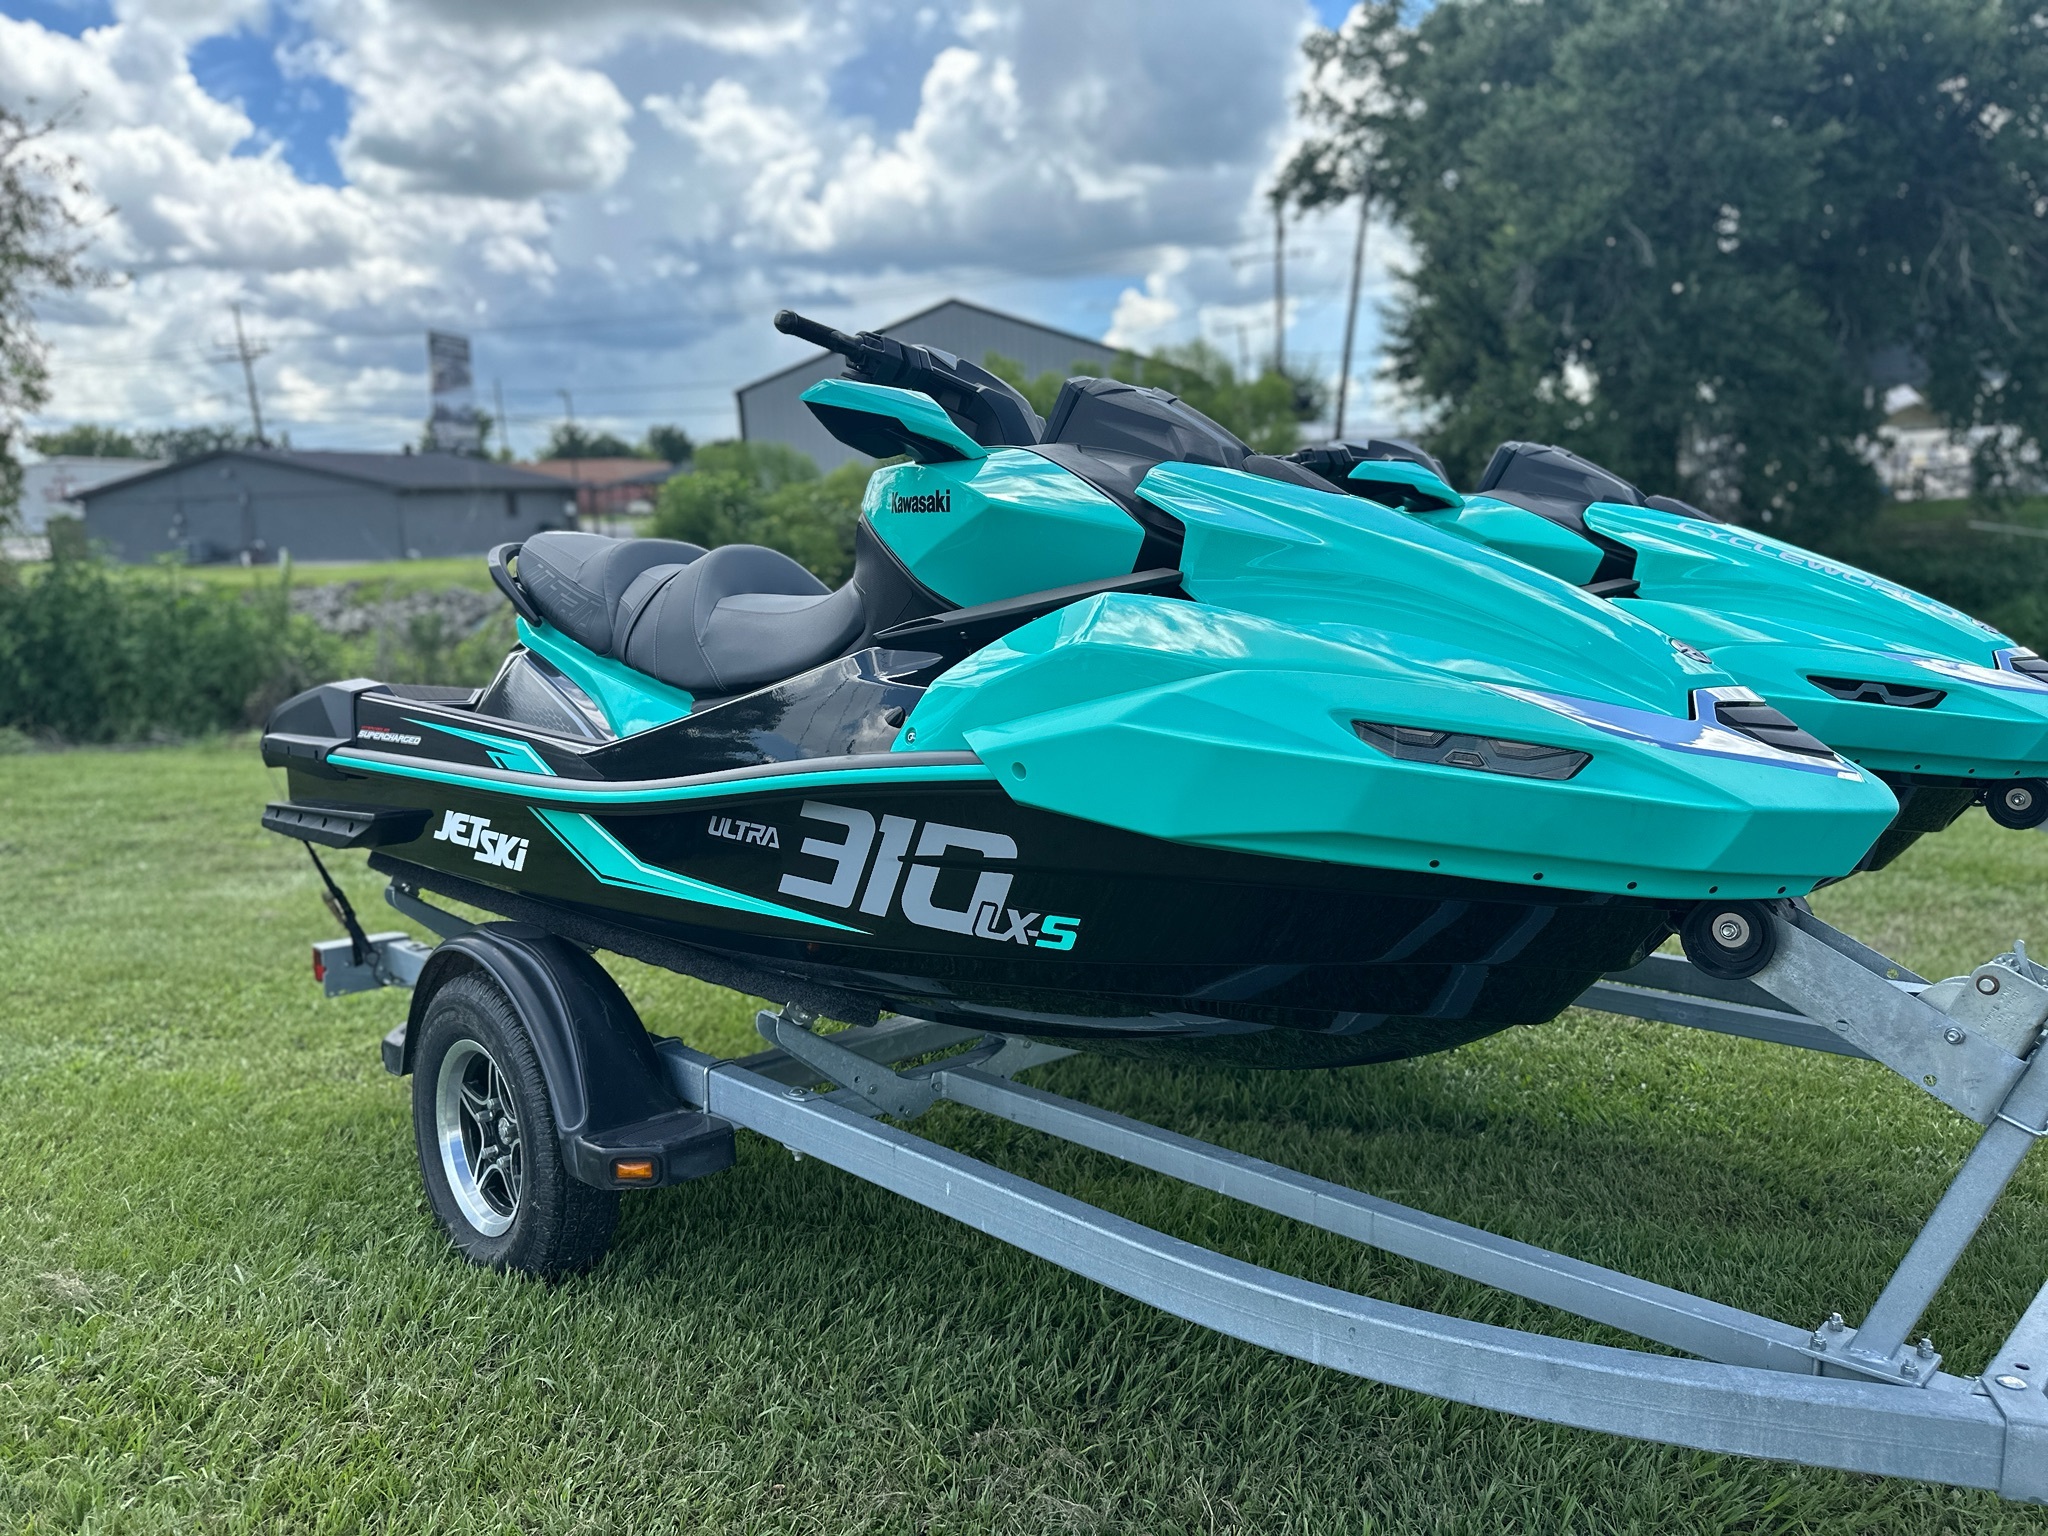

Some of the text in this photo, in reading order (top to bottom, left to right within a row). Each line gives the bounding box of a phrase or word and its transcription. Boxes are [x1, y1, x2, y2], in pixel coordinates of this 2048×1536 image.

[891, 489, 951, 514] Kawasaki
[357, 729, 422, 746] SUPERCHARGED
[707, 815, 780, 849] ULTRA
[777, 799, 1018, 936] 310
